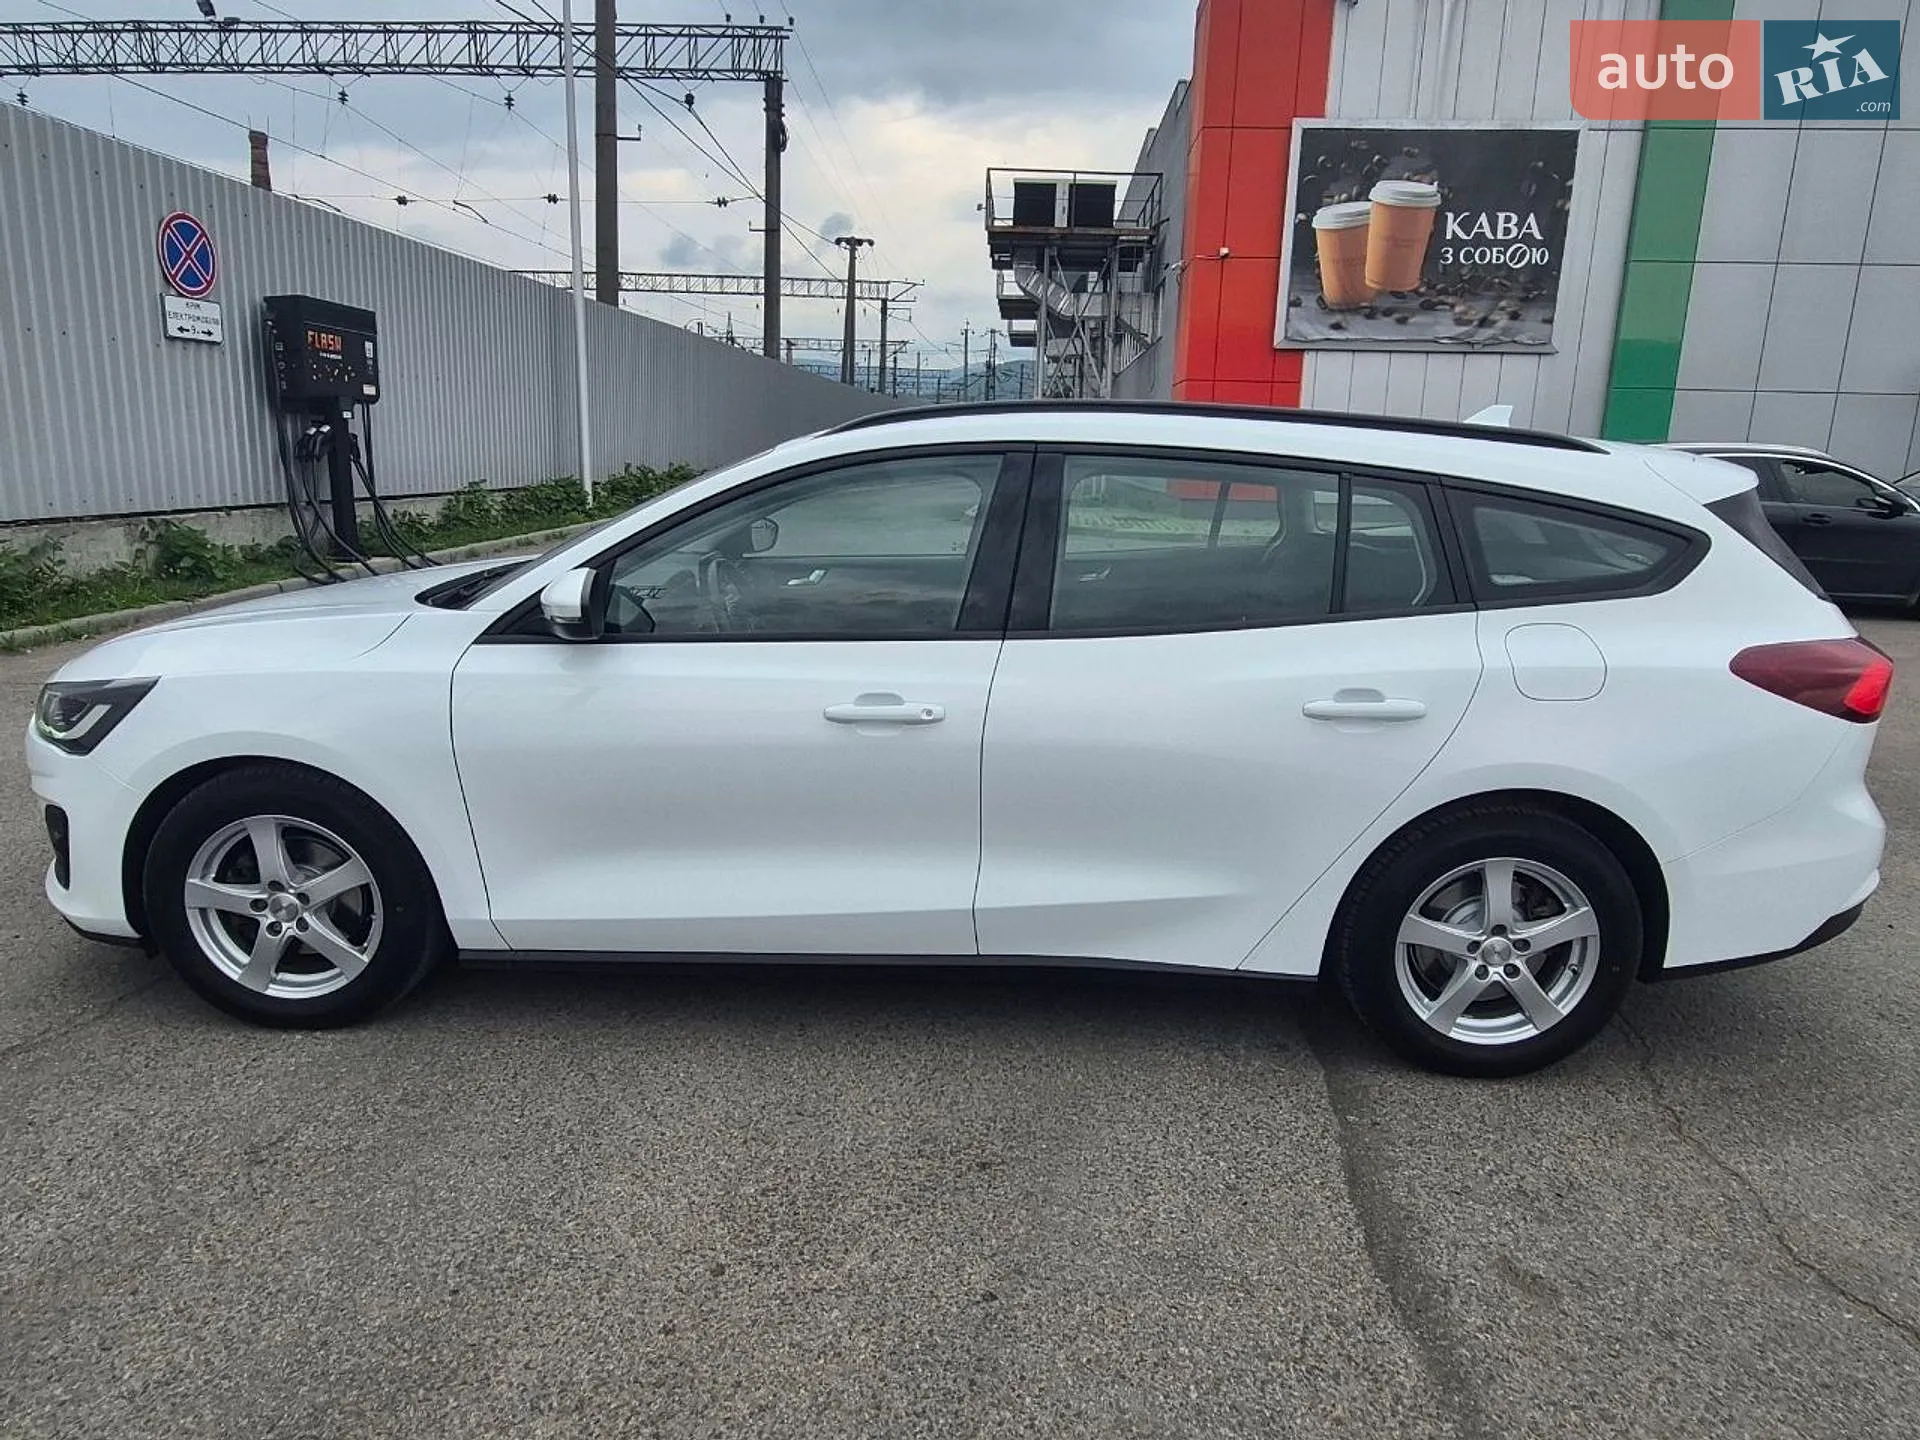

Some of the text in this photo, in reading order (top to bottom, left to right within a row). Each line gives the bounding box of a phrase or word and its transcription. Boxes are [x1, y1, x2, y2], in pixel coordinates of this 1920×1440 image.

[1445, 211, 1544, 240] КАВА
[1440, 243, 1550, 269] З СОБОЮ
